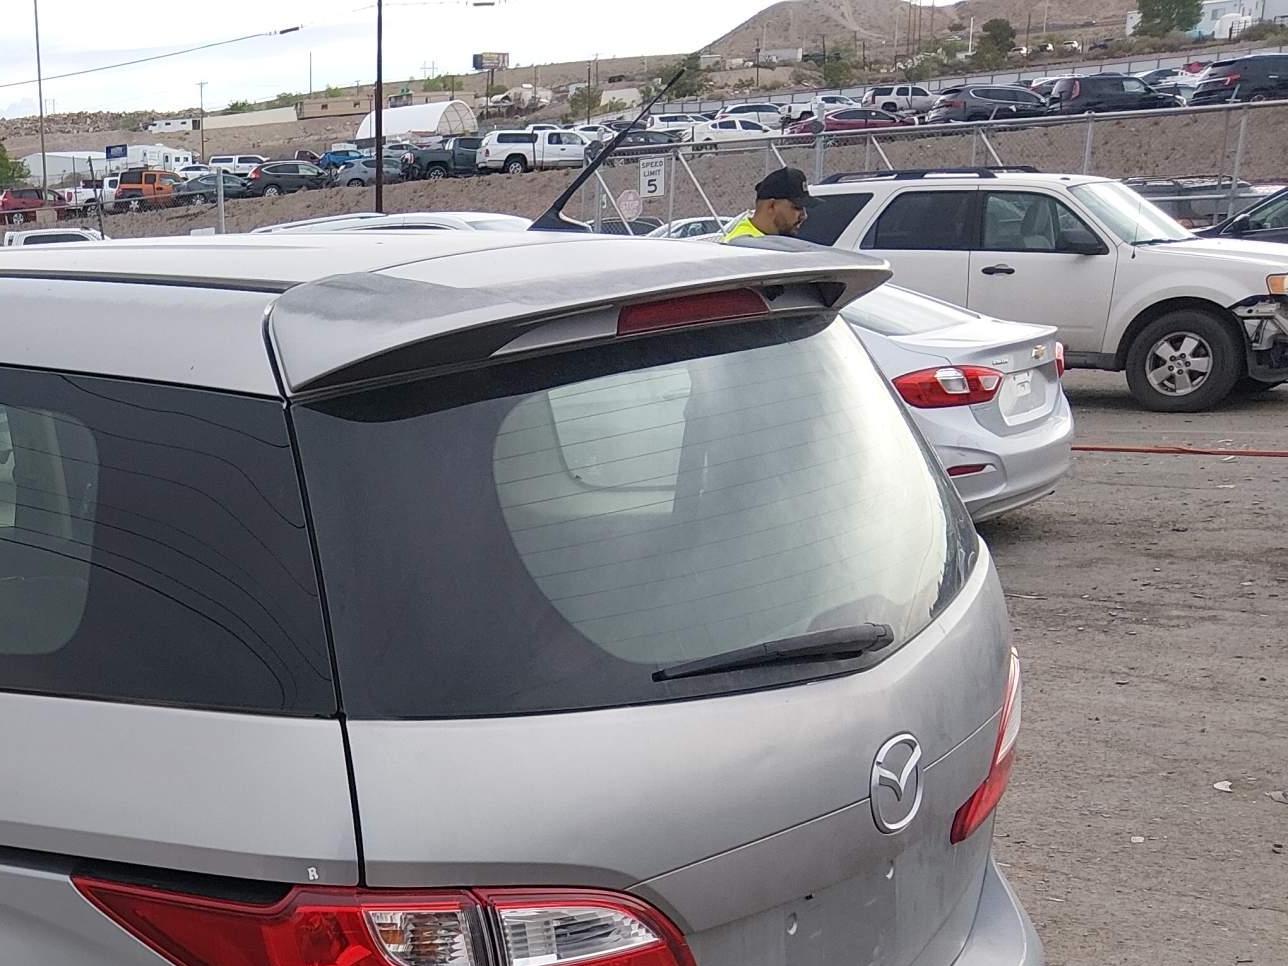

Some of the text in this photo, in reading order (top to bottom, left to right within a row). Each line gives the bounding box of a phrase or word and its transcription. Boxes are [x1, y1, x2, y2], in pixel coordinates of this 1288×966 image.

[641, 160, 663, 168] SPEED
[643, 169, 661, 177] LIMIT
[647, 178, 658, 194] 5
